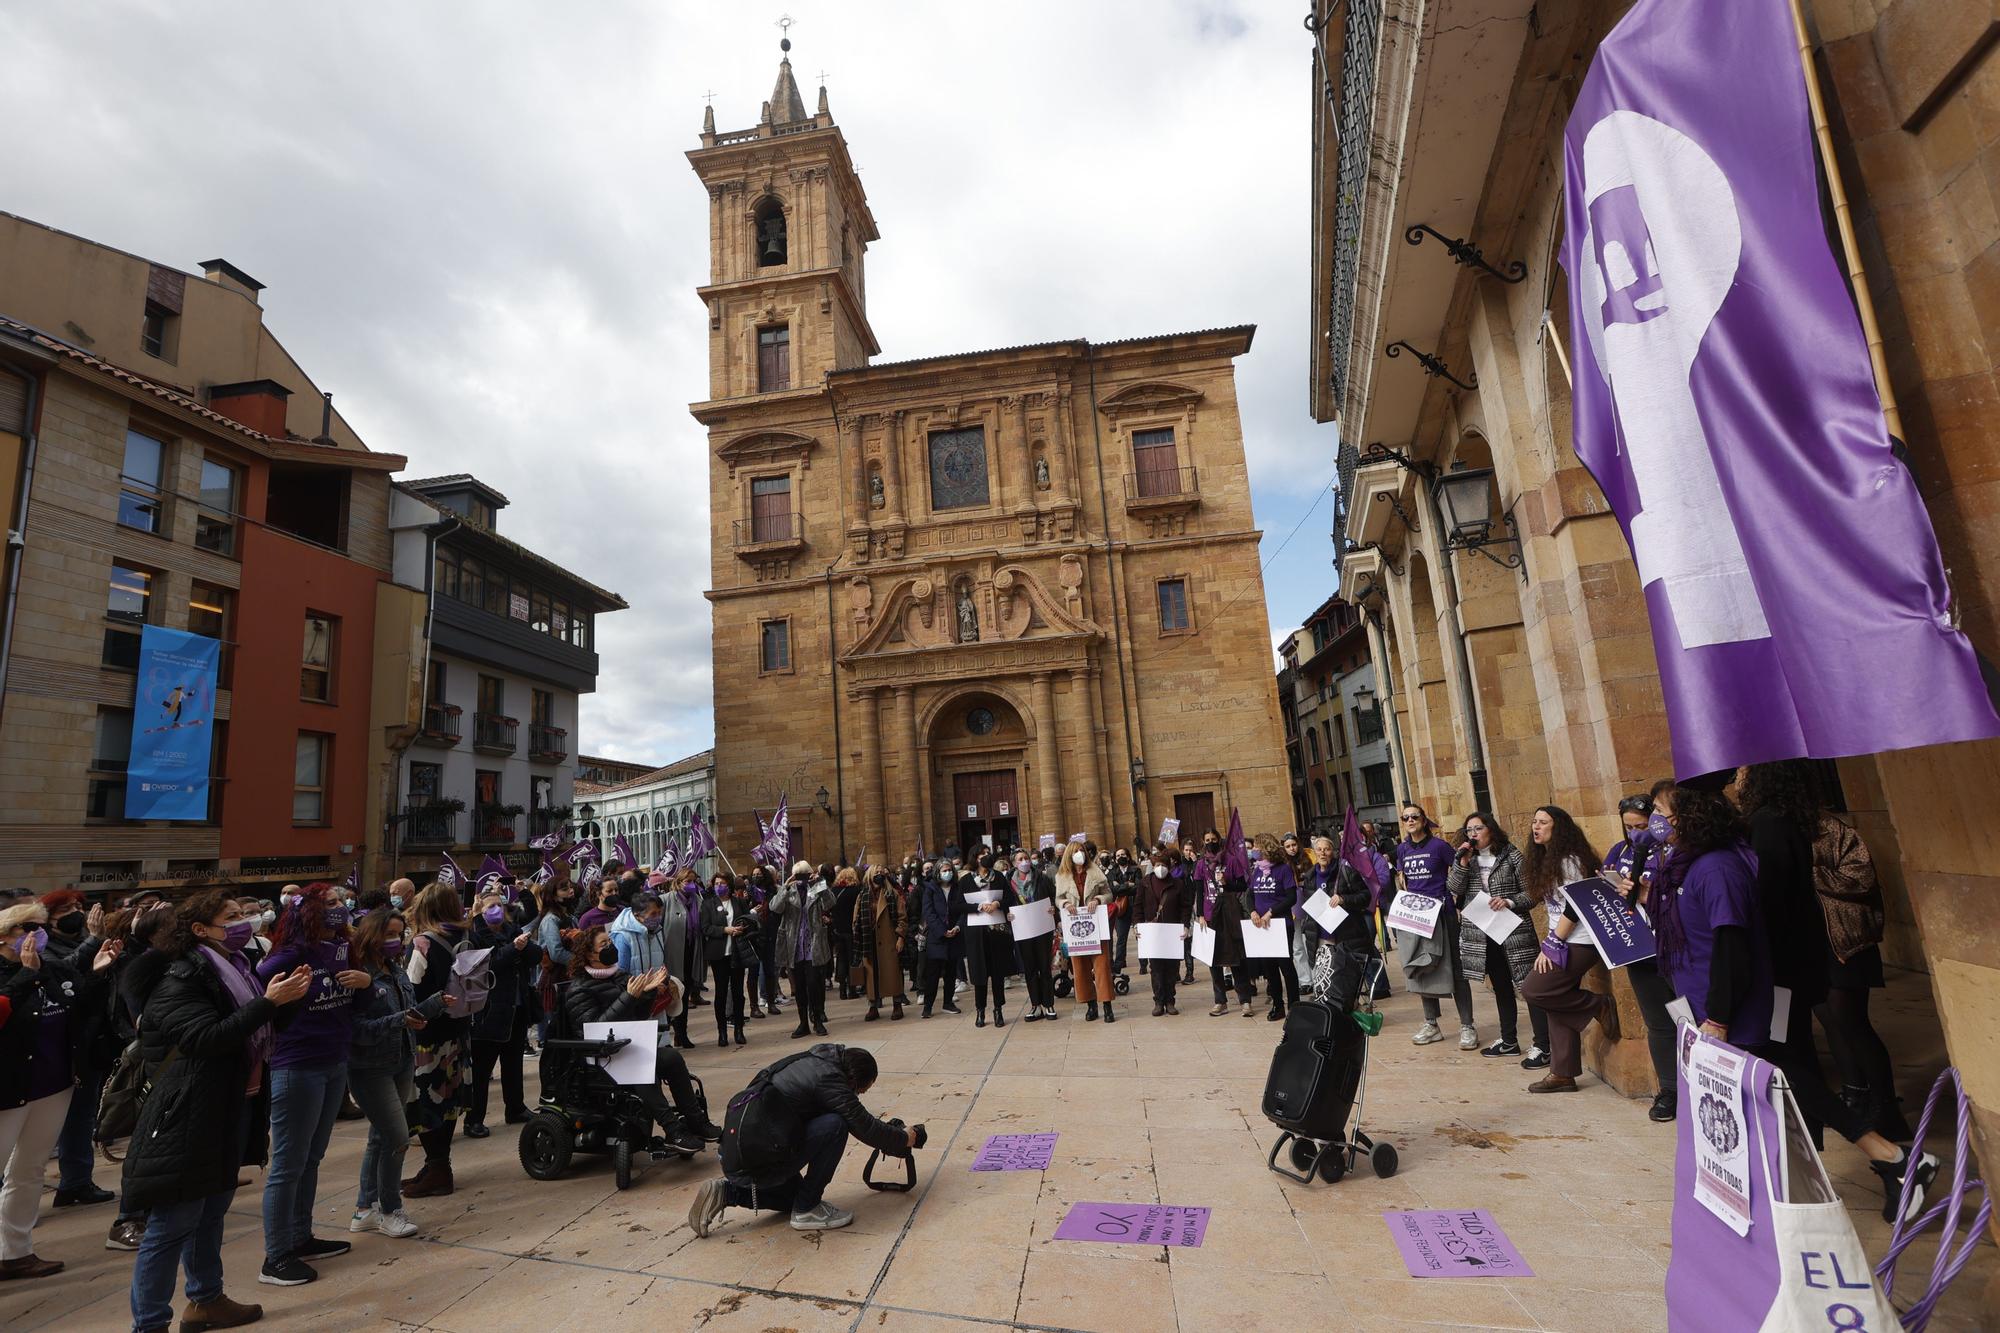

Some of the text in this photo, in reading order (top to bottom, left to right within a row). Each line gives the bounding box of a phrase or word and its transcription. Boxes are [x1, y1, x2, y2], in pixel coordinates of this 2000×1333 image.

[151, 783, 177, 791] OVIEDO
[86, 872, 135, 883] OFICINA
[1414, 915, 1431, 925] TODAS
[1590, 903, 1617, 939] ARENAL
[1592, 889, 1634, 947] CONCEPCIÓN
[1612, 899, 1635, 928] CALLE
[1698, 1072, 1711, 1090] CON
[1711, 1078, 1733, 1101] TODAS
[1702, 1154, 1743, 1194] Y A POR TODAS
[1095, 1211, 1138, 1235] YO
[1144, 1206, 1163, 1224] SOLO
[1800, 1251, 1872, 1290] EL
